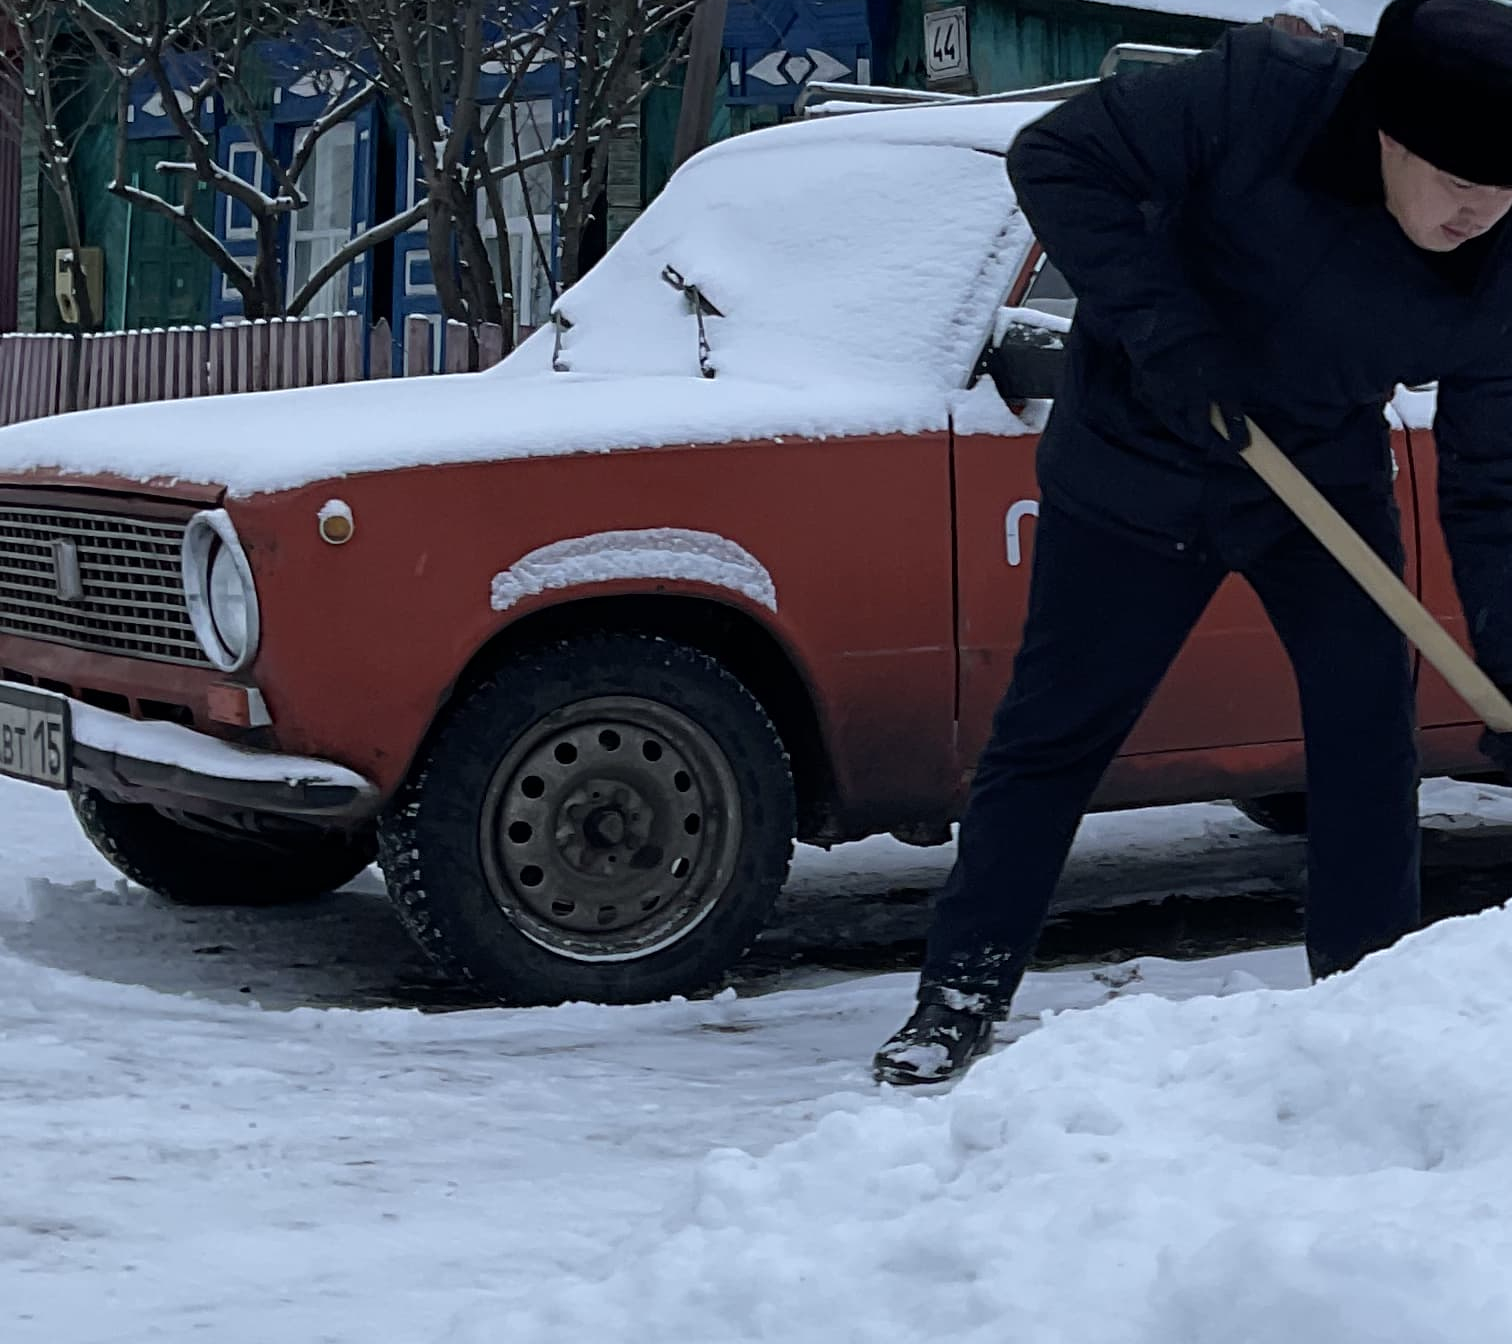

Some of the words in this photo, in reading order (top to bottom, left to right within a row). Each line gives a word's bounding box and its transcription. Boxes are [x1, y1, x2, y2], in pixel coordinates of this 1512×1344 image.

[933, 24, 955, 62] 44
[0, 724, 26, 769] BT
[33, 720, 61, 775] 15
